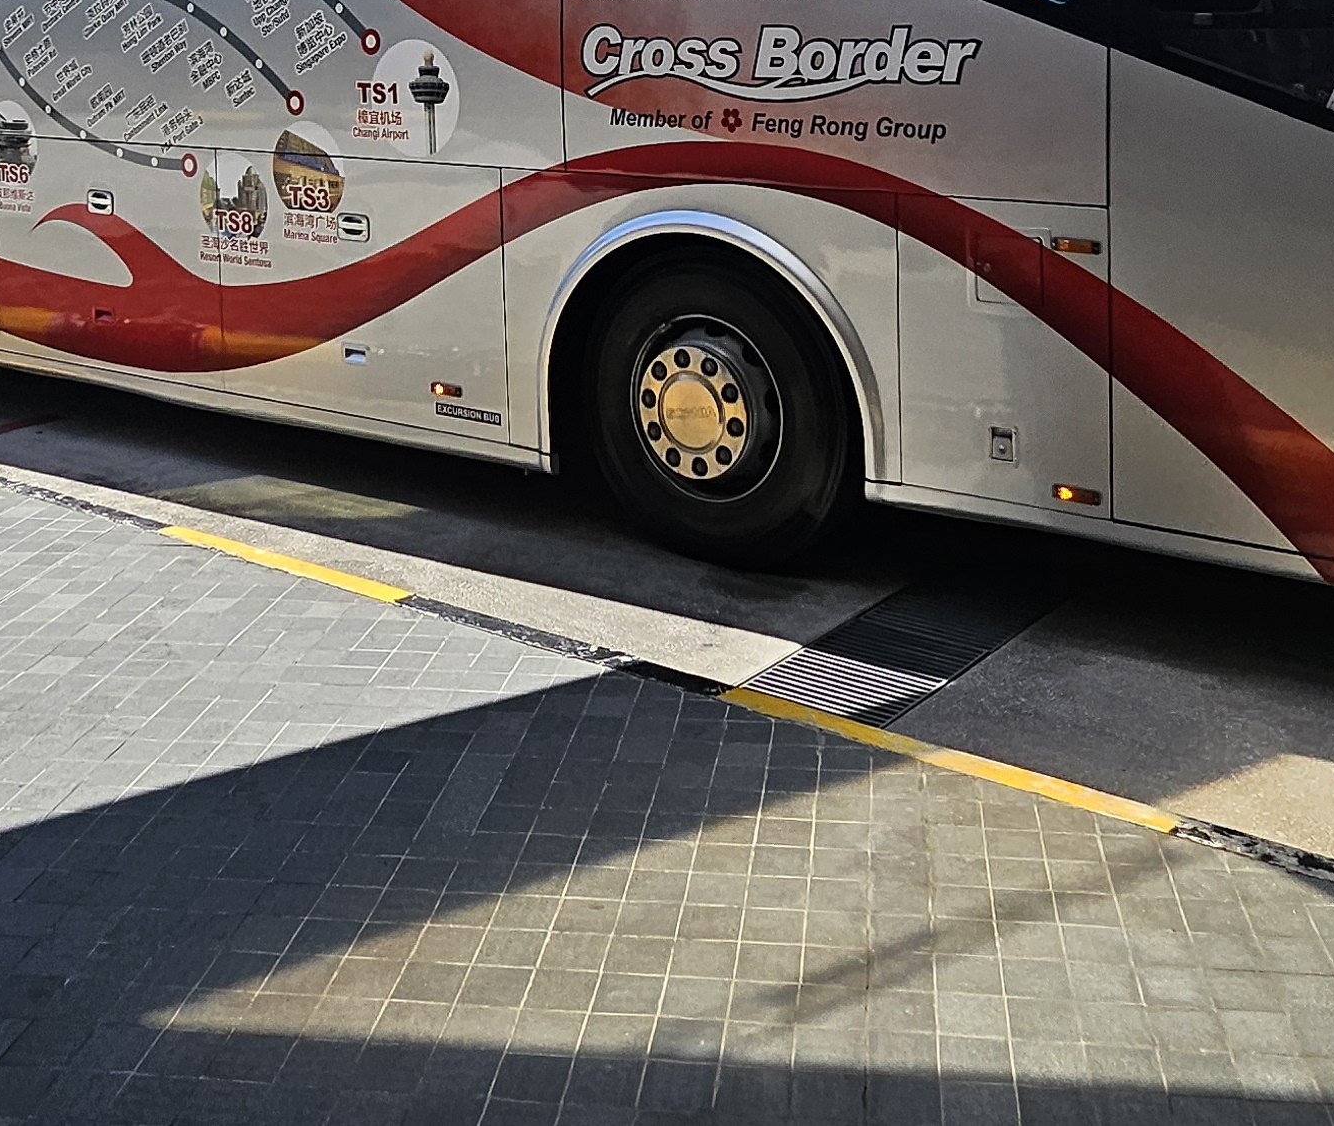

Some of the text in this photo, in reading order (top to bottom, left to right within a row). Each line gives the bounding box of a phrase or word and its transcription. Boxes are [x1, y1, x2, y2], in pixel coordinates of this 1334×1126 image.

[581, 23, 983, 85] Cross Border
[357, 82, 399, 103] TS1
[357, 110, 402, 126] 樟宜机场
[609, 107, 948, 143] Member of Feng Rong Group
[353, 126, 409, 141] Changi Airport
[289, 186, 330, 210] TS3
[215, 210, 252, 234] TS8
[283, 213, 337, 230] 滨海湾广场
[283, 229, 338, 244] Marina Square
[222, 253, 243, 265] World
[243, 255, 272, 269] Sentosa
[436, 403, 501, 424] EXCURSION BUS
